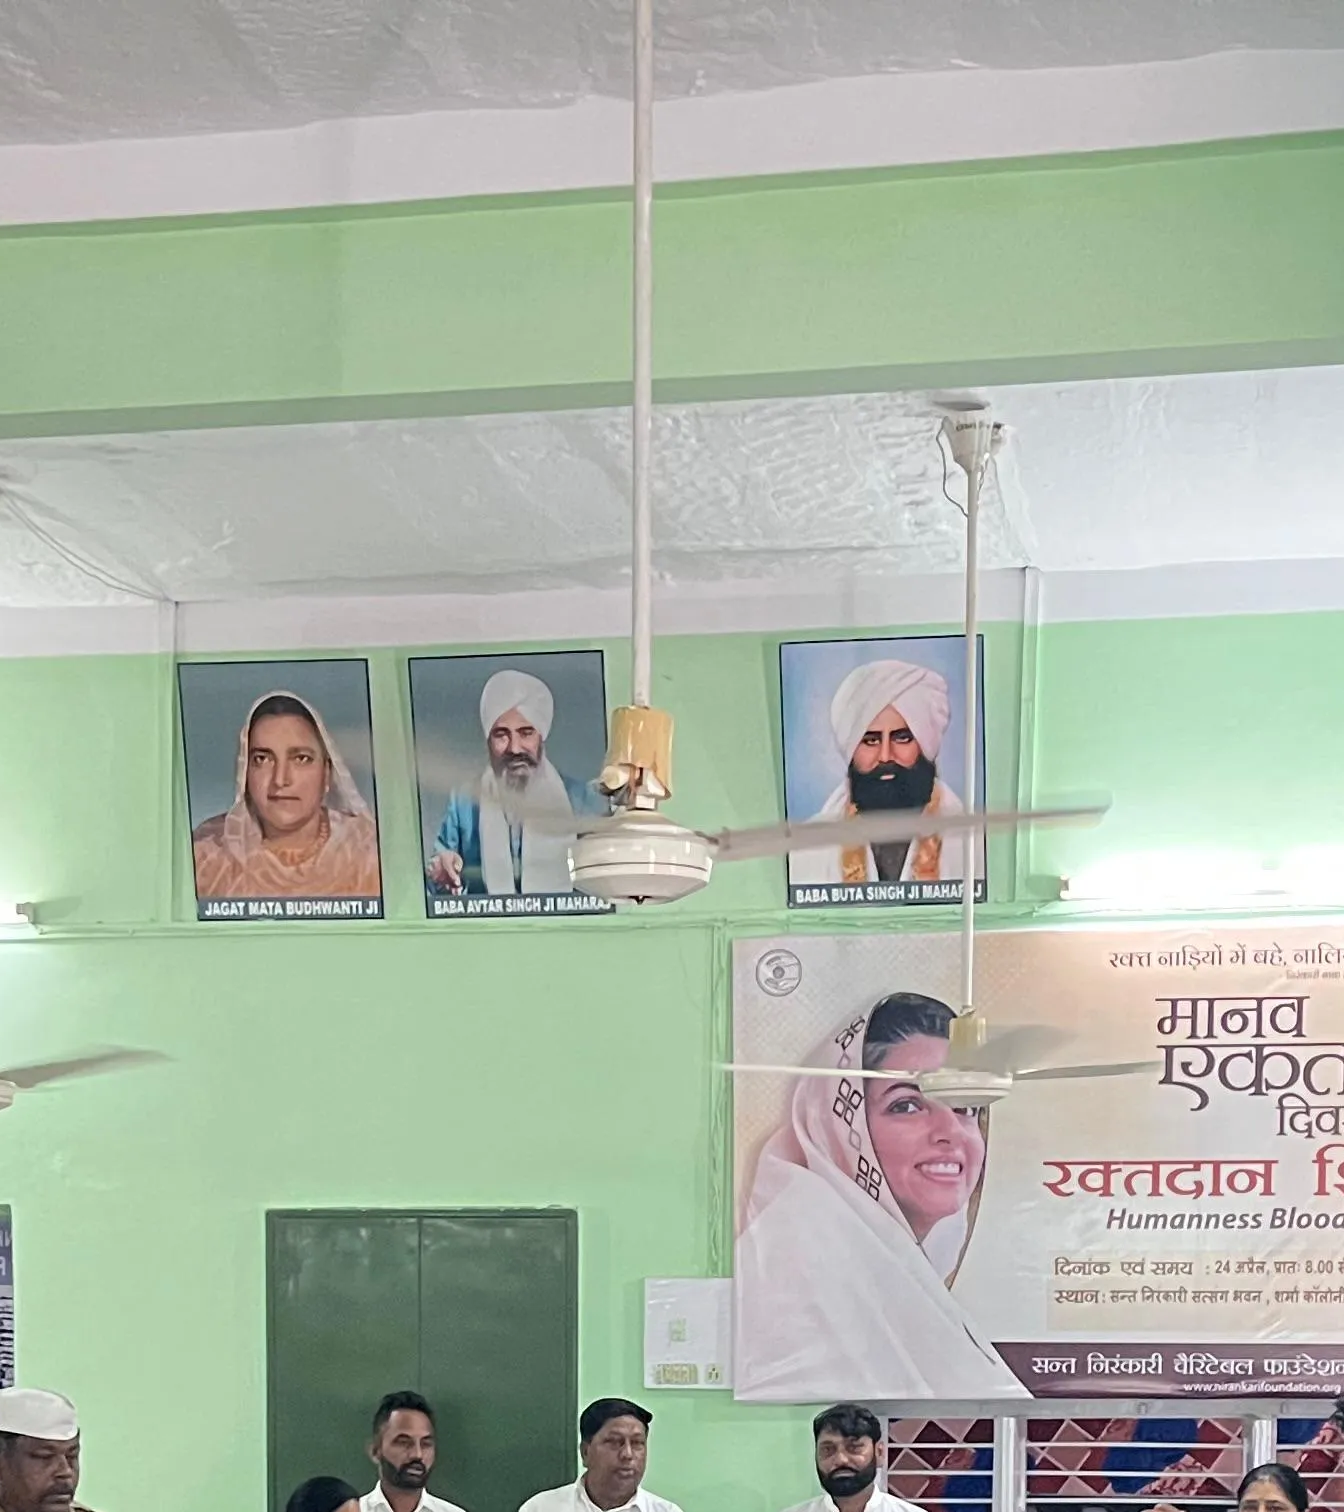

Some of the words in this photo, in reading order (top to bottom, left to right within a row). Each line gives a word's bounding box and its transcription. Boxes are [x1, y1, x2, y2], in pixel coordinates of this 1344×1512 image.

[796, 889, 828, 903] BABA
[831, 887, 864, 902] BUTA
[866, 886, 905, 900] SINGH
[908, 885, 920, 899] JI
[922, 883, 982, 898] MAHARJ
[205, 902, 245, 916] JAGAT
[249, 901, 283, 915] MATA
[286, 900, 363, 915] BUDHWANTI
[366, 900, 378, 915] JI
[434, 900, 464, 914] BABA
[467, 899, 503, 913] AVTAR
[506, 898, 541, 912] SINGH
[543, 897, 555, 912] JI
[1229, 942, 1246, 966] में
[1155, 996, 1310, 1040] मानव
[1042, 1160, 1279, 1200] रक्तदान
[1106, 1207, 1263, 1231] Humanness
[1055, 1256, 1111, 1276] दिनांक
[1121, 1258, 1145, 1276] एवं
[1150, 1261, 1193, 1276] समय
[1215, 1260, 1230, 1275] 24
[1306, 1259, 1334, 1275] 8.00
[1032, 1356, 1077, 1375] सन्त
[1087, 1352, 1163, 1375] निरंकारी
